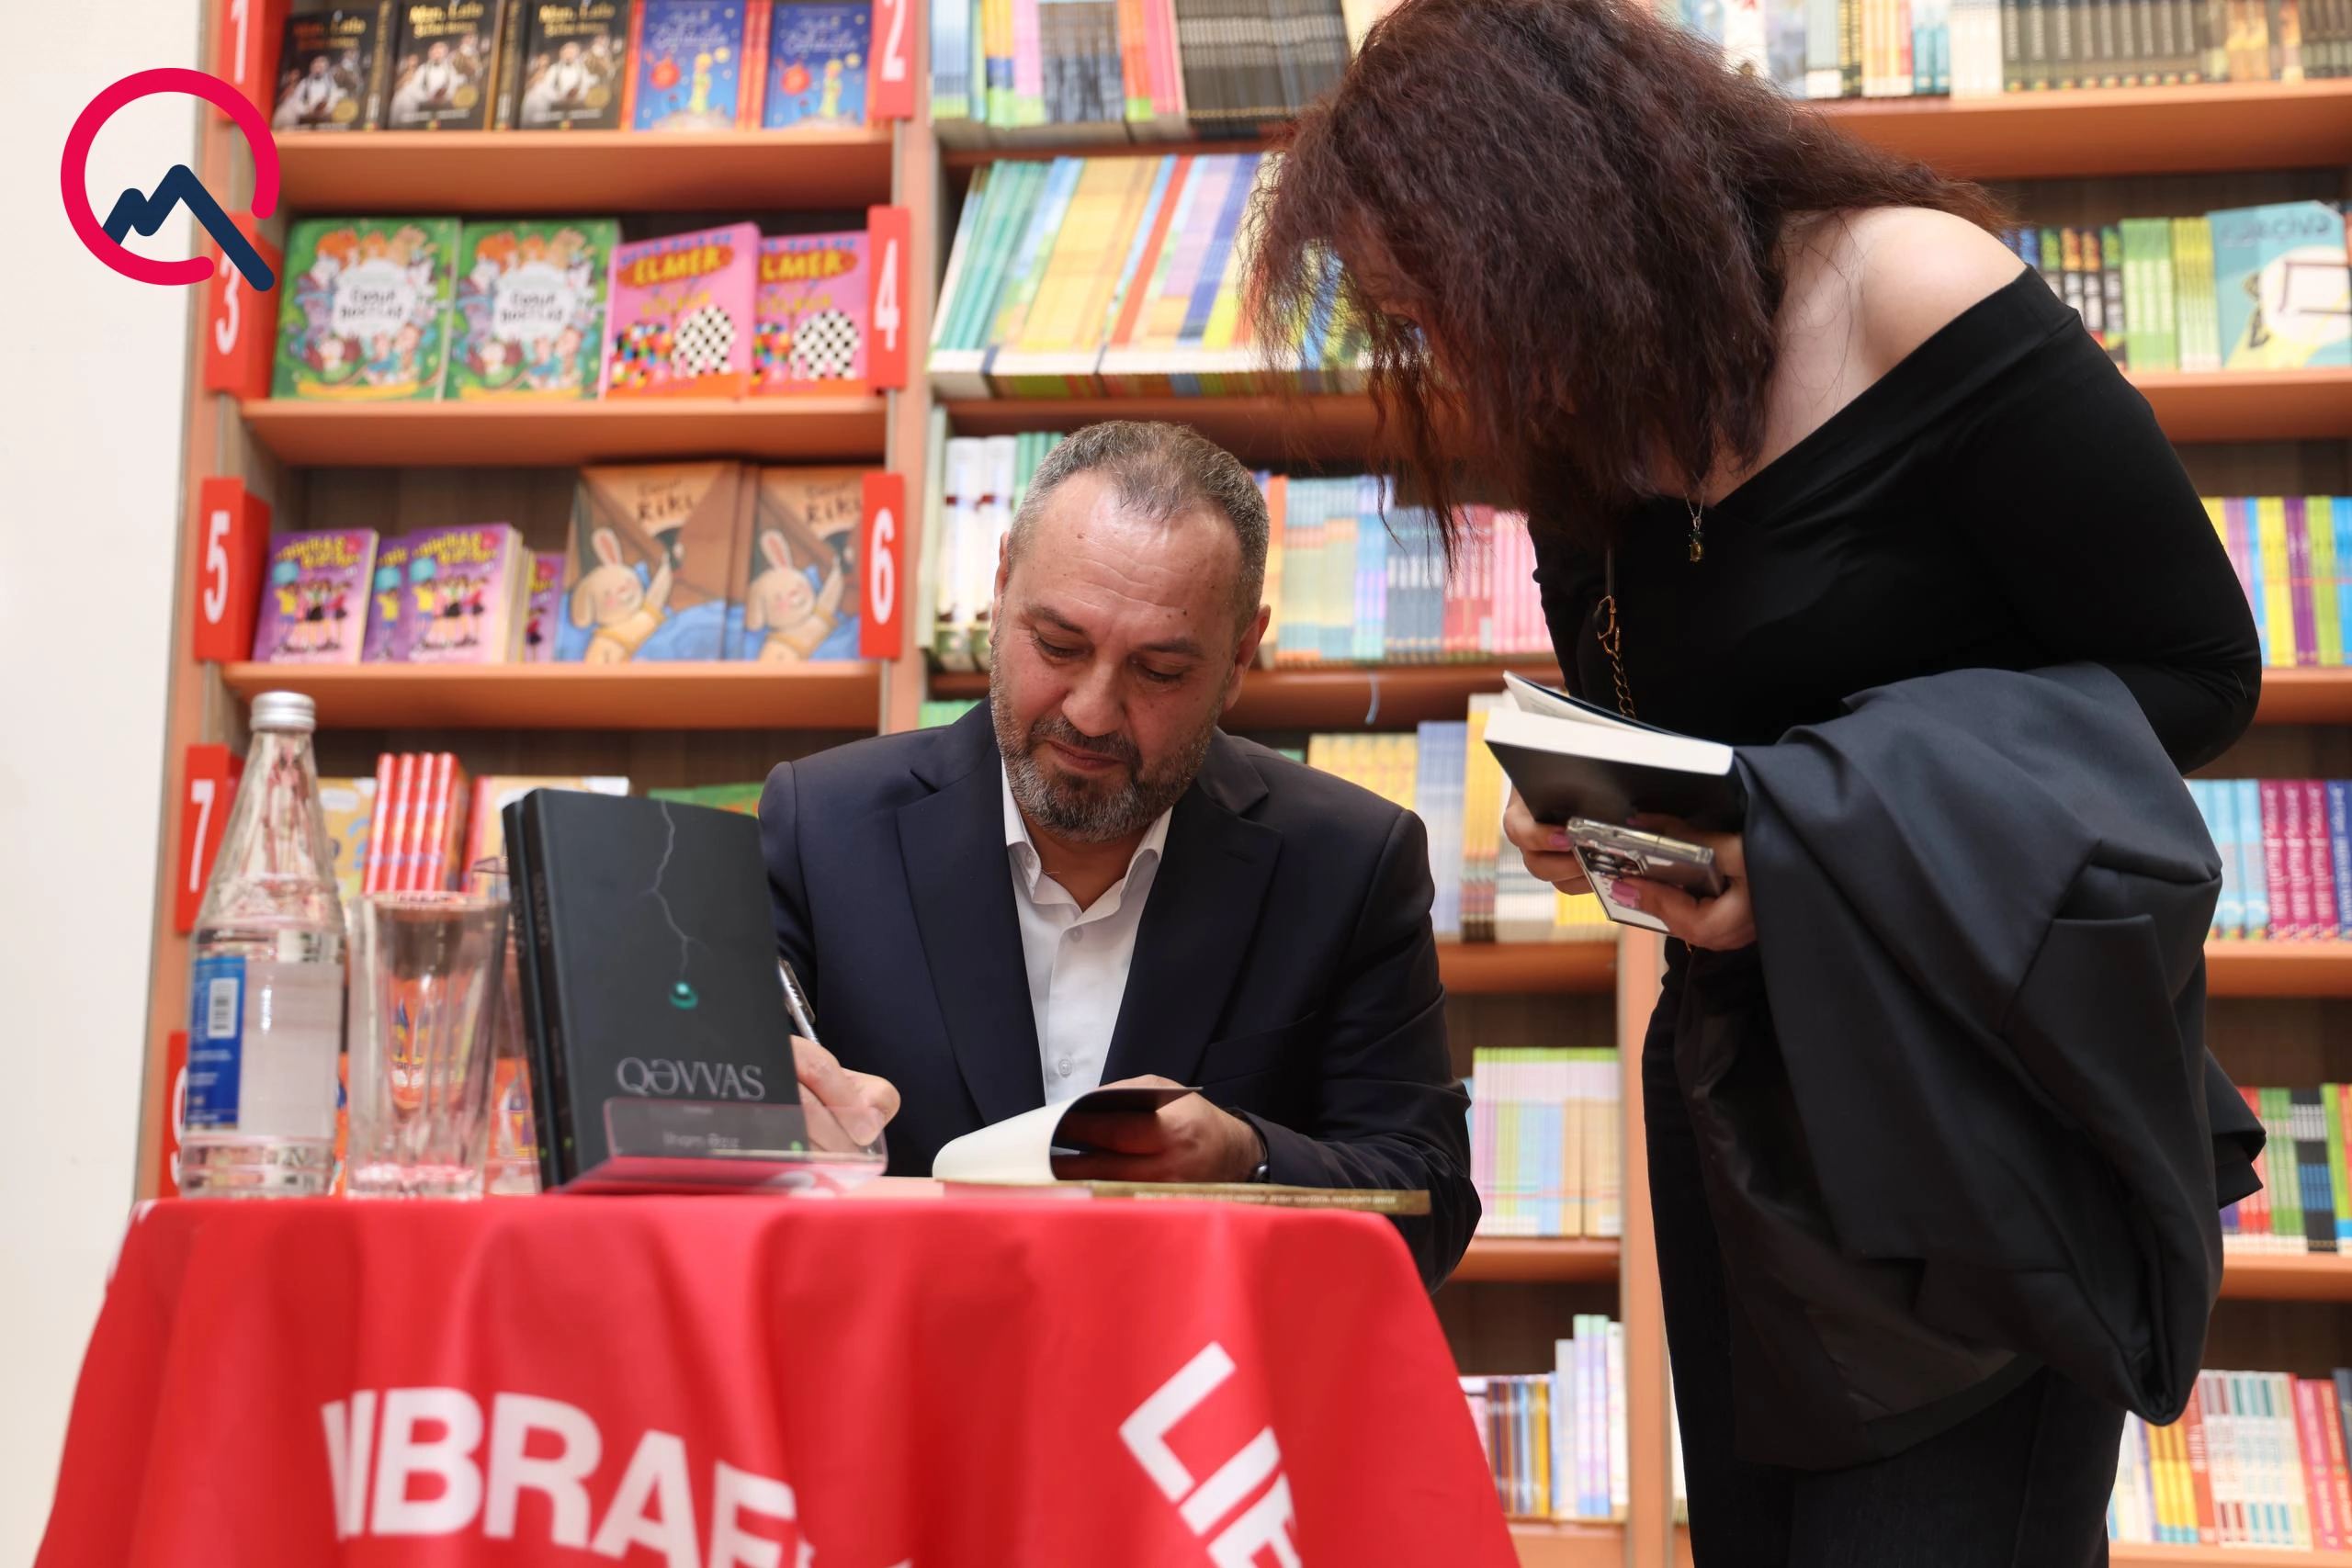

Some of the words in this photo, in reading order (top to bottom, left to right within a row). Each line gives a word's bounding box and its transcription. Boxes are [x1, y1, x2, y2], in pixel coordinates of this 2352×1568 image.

[230, 0, 249, 85] 1
[880, 0, 906, 82] 2
[215, 253, 241, 355] 3
[633, 245, 721, 286] ELMER
[760, 249, 842, 281] LMER
[874, 239, 899, 351] 4
[203, 510, 230, 624] 5
[870, 508, 895, 625] 6
[189, 779, 215, 893] 7
[616, 1056, 766, 1101] QƏVVAS
